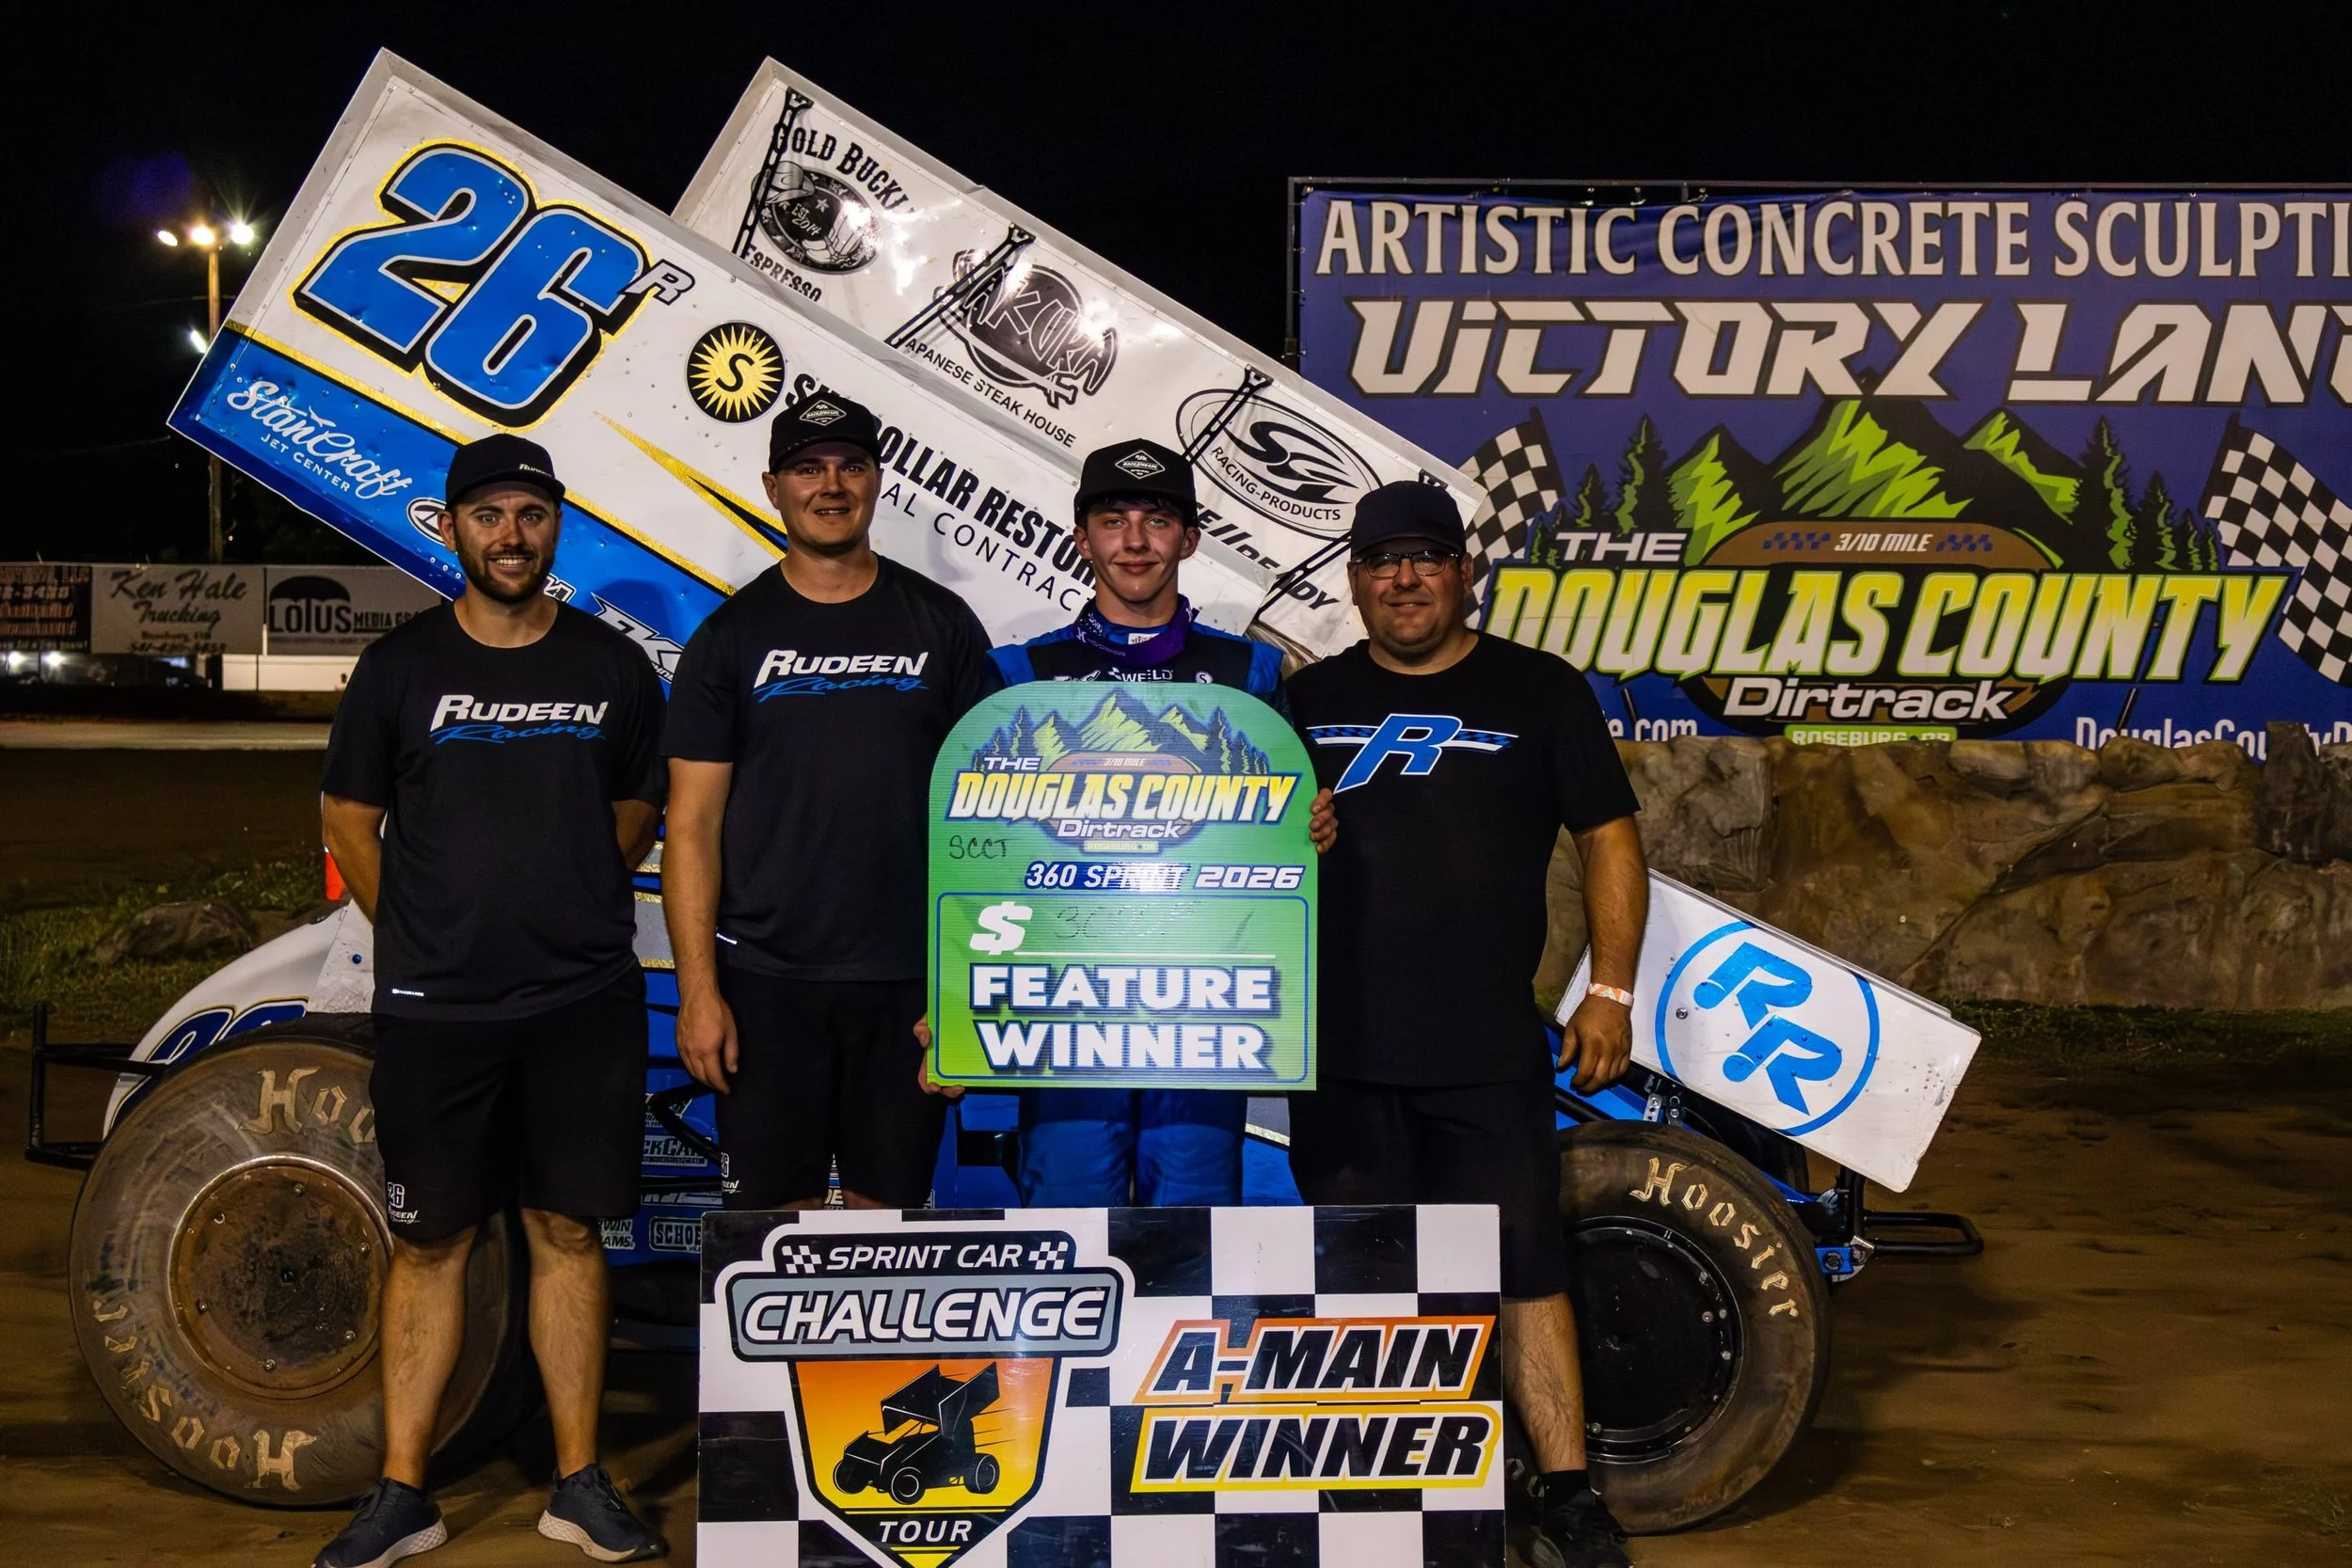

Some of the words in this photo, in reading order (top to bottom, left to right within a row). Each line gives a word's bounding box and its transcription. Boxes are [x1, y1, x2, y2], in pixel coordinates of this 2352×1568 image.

[791, 217, 822, 236] 2014
[1314, 199, 1637, 277] ARTISTIC
[1658, 200, 2030, 277] CONCRETE
[292, 139, 651, 428] 26
[618, 259, 695, 305] R
[932, 247, 1119, 396] AKURA
[2007, 302, 2352, 404] LAN
[898, 337, 975, 386] APANESE
[973, 377, 1025, 417] STEAK
[1022, 407, 1077, 449] HOUSE
[227, 380, 413, 499] StanCraft
[260, 433, 290, 454] JET
[293, 451, 352, 493] CENTER
[873, 414, 980, 512] OLLAR
[972, 485, 1097, 590] RESTOR
[1211, 446, 1342, 522] RACING-PRODUCTS
[932, 512, 1090, 612] CONTRAC
[1555, 531, 1688, 562] THE
[1834, 531, 1881, 552] 3/10
[1881, 531, 1933, 552] MILE
[110, 570, 167, 599] Ken
[174, 568, 247, 601] Hale
[132, 598, 222, 632] Trucking
[268, 597, 352, 634] LOTUS
[353, 611, 393, 629] MEDIA
[1484, 567, 1901, 682] DOUGLAS
[1896, 570, 2288, 685] COUNTY
[753, 649, 930, 689] RUDEEN
[753, 673, 931, 704] Racing
[429, 693, 609, 733] RUDEEN
[1723, 676, 2018, 721] Dirtrack
[429, 721, 607, 744] Racing
[1332, 713, 1464, 796] R
[983, 756, 1041, 771] THE
[1122, 757, 1146, 768] MILE
[947, 771, 1135, 824] DOUGLAS
[1131, 773, 1298, 824] COUNTY
[1057, 818, 1182, 838] Dirtrack
[1025, 863, 1078, 889] 360
[1193, 865, 1306, 890] 2026
[969, 900, 1034, 956] $
[971, 964, 1273, 1012] FEATURE
[976, 1021, 1267, 1070] WINNER
[826, 1243, 951, 1271] SPRINT
[956, 1243, 1024, 1269] CAR
[743, 1289, 1106, 1343] CHALLENGE
[1149, 1326, 1480, 1394] A-MAIN
[1143, 1414, 1492, 1481] WINNER
[878, 1519, 973, 1544] TOUR
